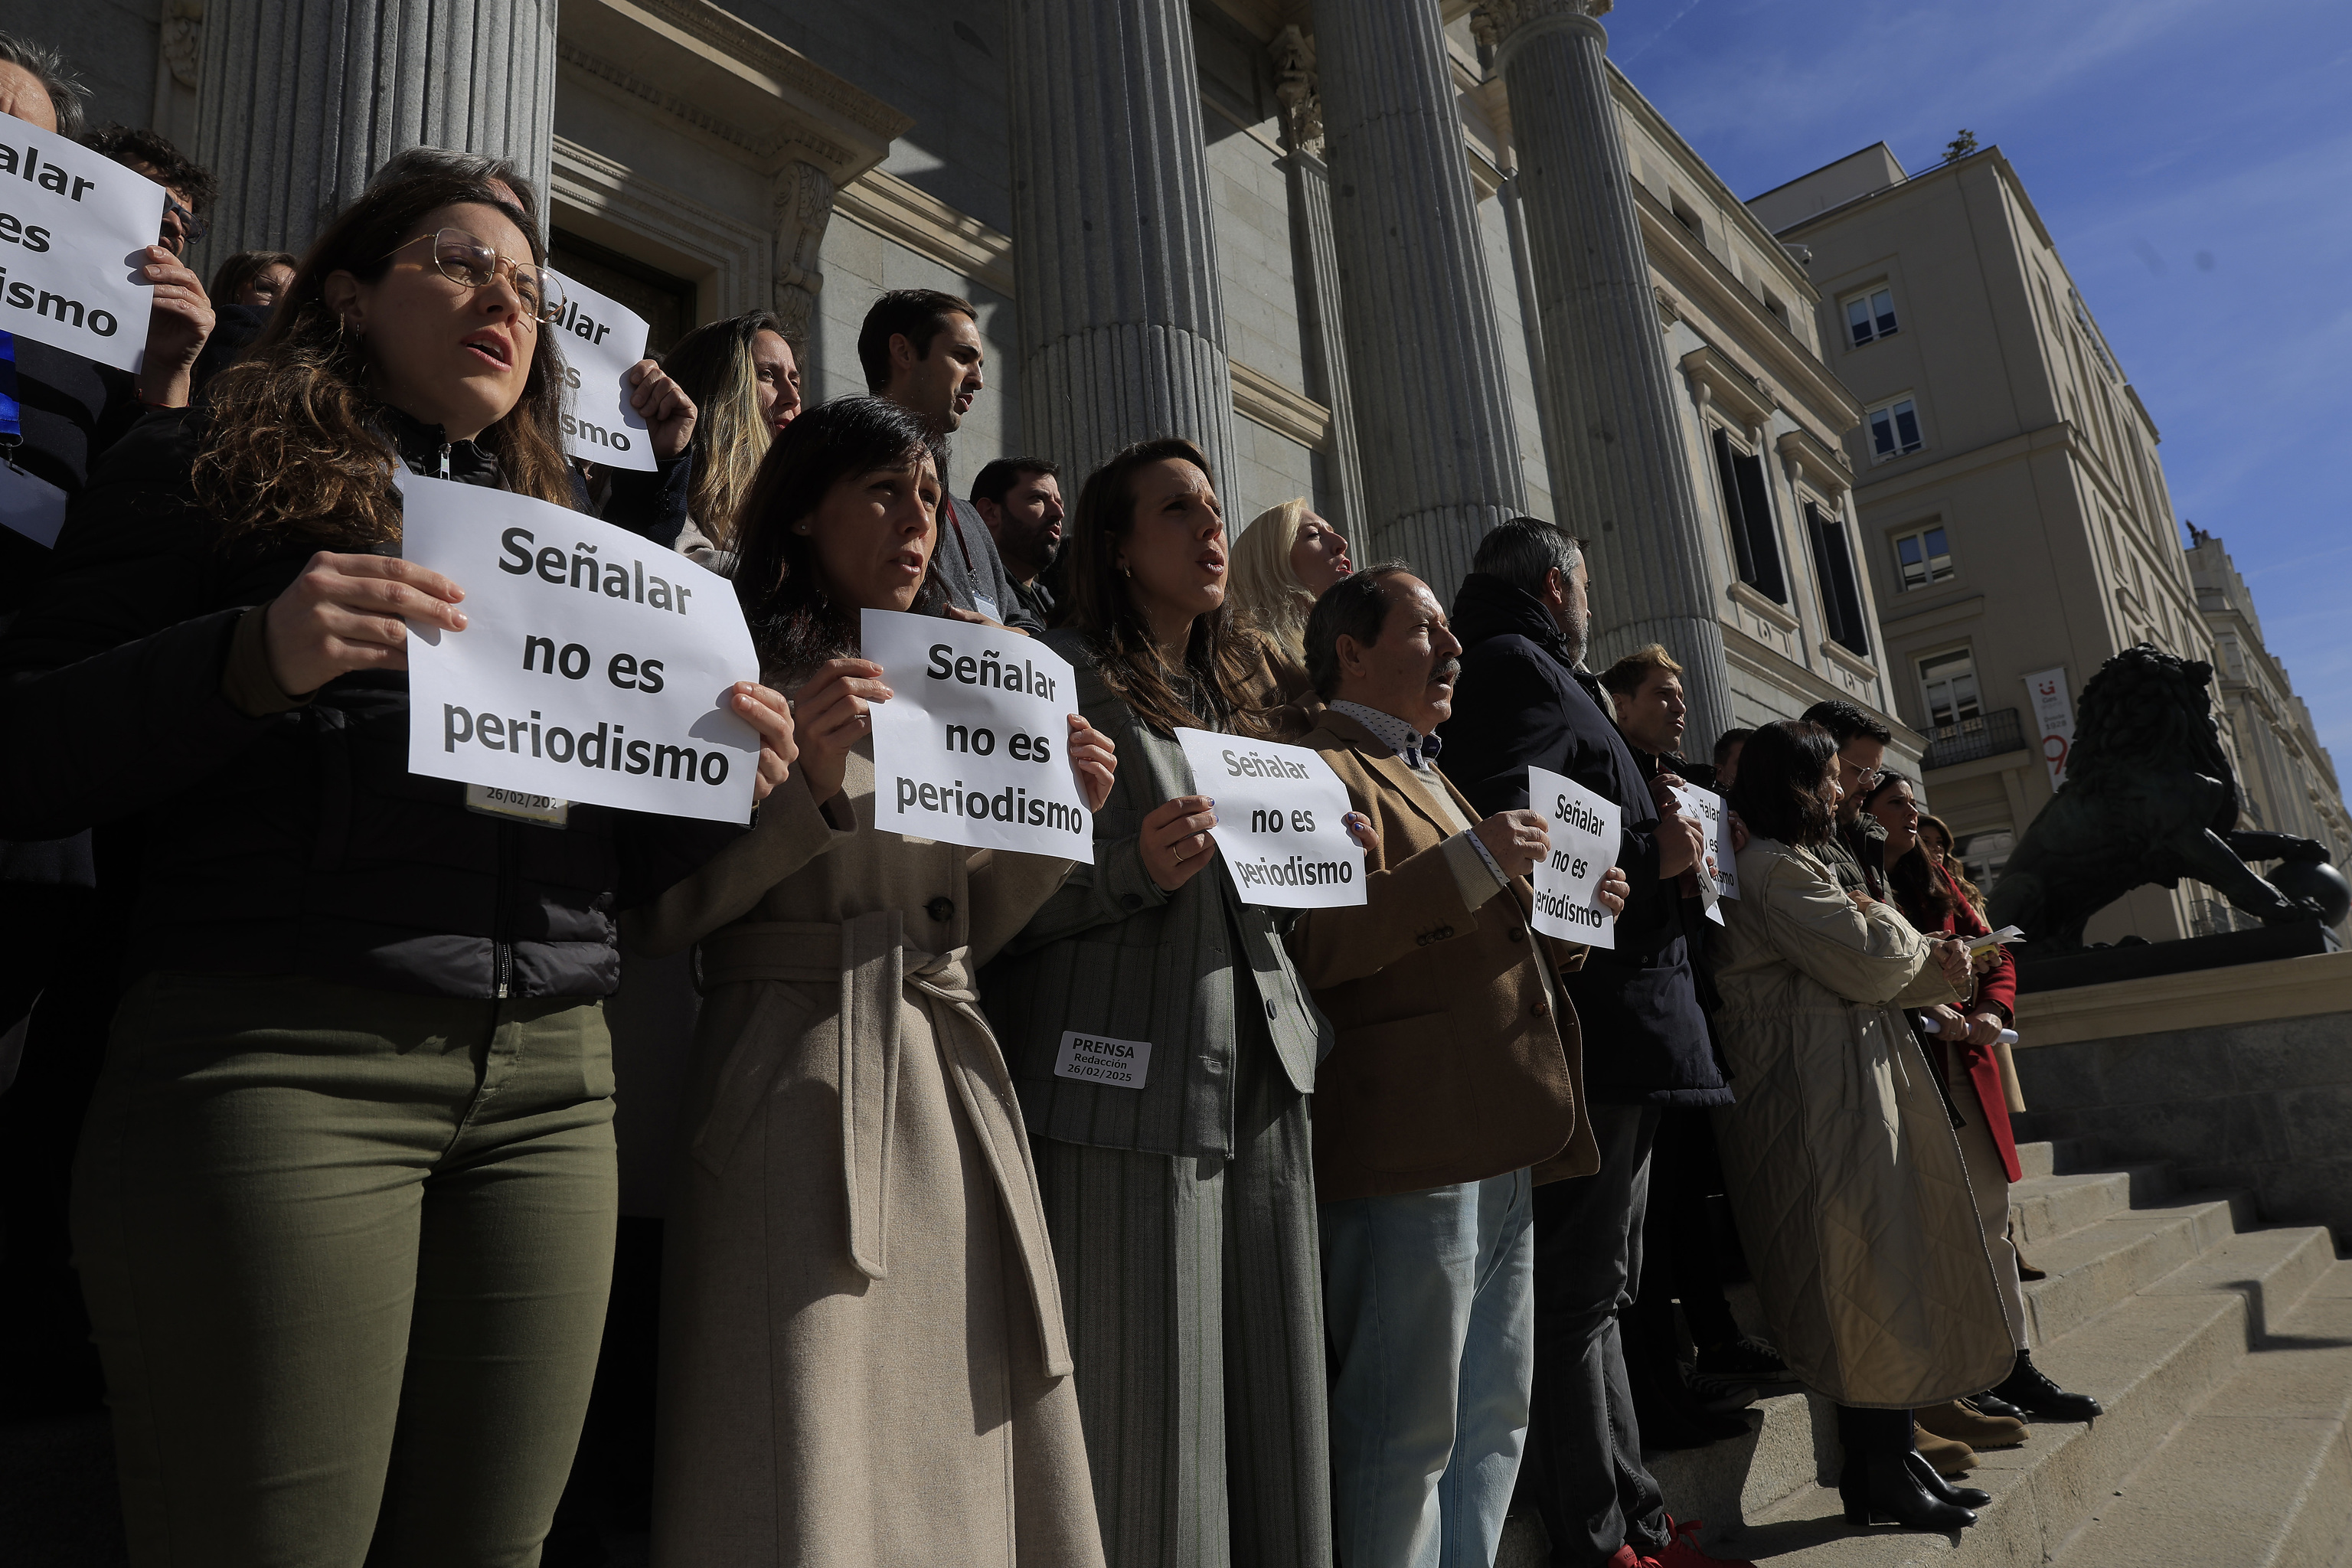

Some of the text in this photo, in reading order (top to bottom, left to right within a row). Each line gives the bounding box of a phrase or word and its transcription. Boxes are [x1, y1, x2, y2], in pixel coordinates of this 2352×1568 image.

[0, 212, 51, 253] es
[498, 527, 692, 616] Señalar
[522, 634, 665, 694] no es
[926, 643, 1057, 703] Señalar
[443, 701, 730, 787] periodismo
[946, 723, 1051, 763] no es
[1222, 749, 1310, 779] Señalar
[896, 776, 1083, 835] periodismo
[1251, 808, 1316, 834] no es
[1554, 793, 1605, 838] Señalar
[1233, 855, 1353, 889] periodismo
[1551, 848, 1589, 879] no es
[1072, 1037, 1135, 1059] PRENSA
[1073, 1053, 1128, 1070] Redacción
[1067, 1063, 1132, 1082] 26/02/2025
